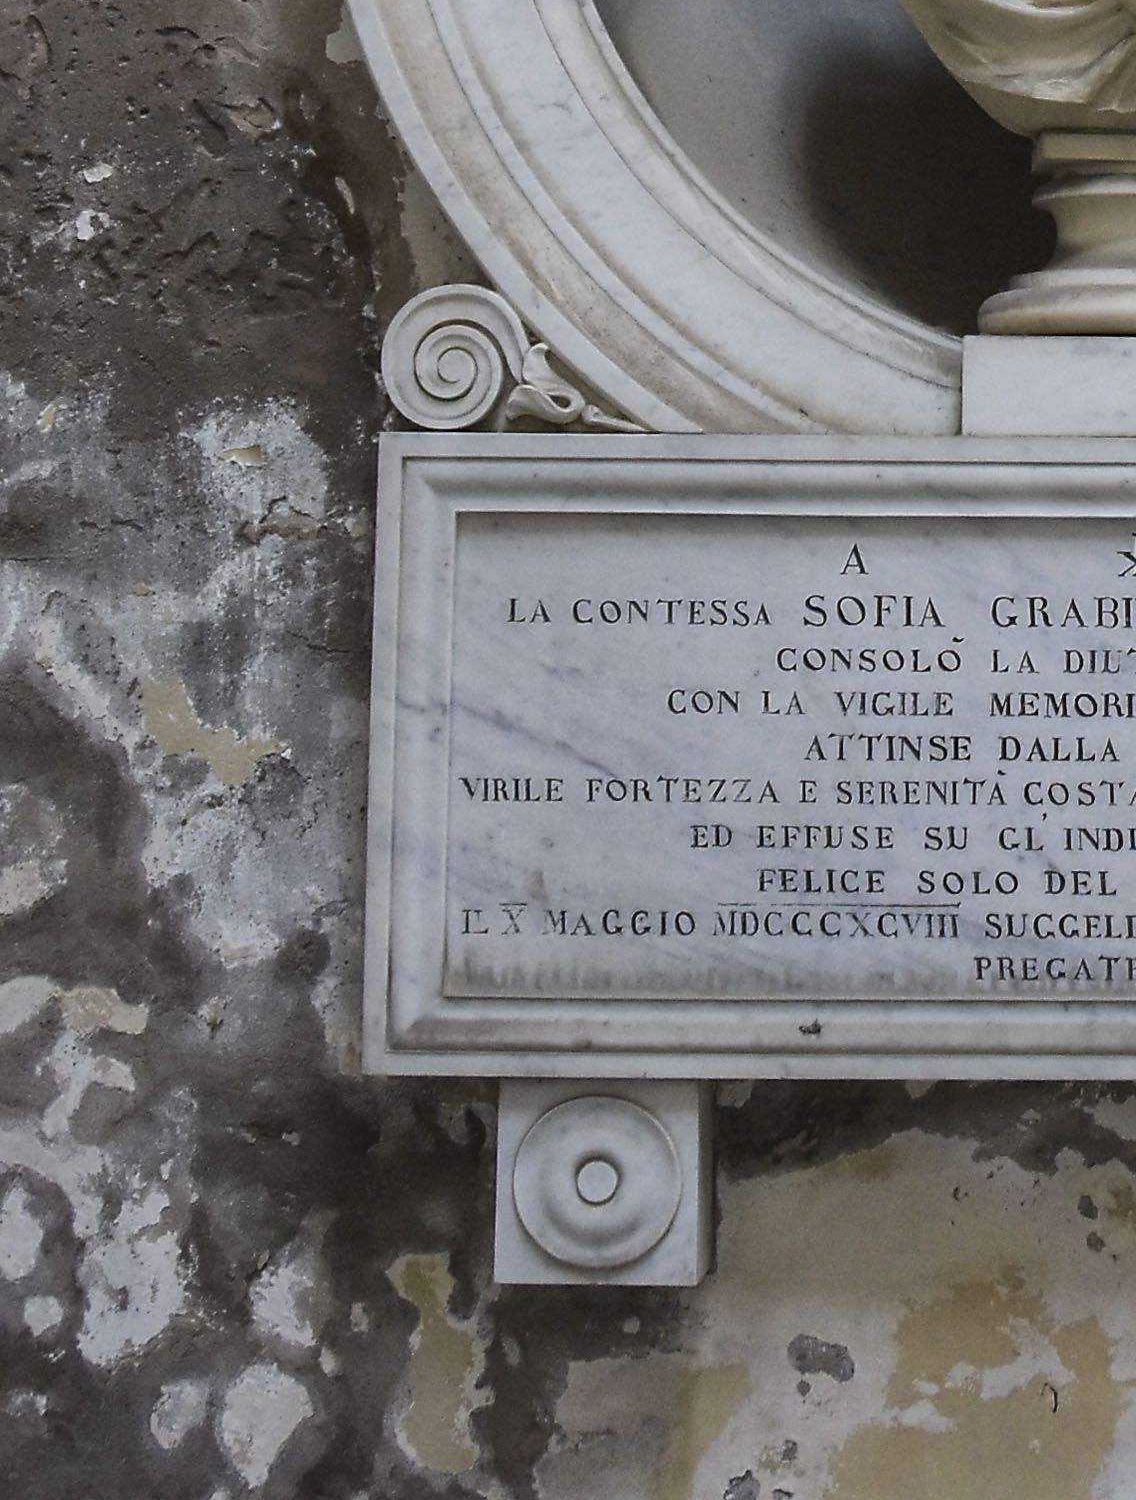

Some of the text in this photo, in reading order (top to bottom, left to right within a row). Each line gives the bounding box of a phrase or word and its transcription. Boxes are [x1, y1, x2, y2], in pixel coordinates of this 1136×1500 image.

[506, 597, 552, 625] LA
[572, 598, 773, 627] CONTESSA
[802, 594, 947, 628] SOFIA
[990, 648, 1040, 675] LA
[667, 688, 741, 715] CON
[761, 690, 806, 716] LA
[834, 690, 955, 717] VIGILE
[803, 732, 972, 762] ATTINSE
[998, 736, 1121, 763] DALLA
[458, 776, 564, 803] VIRILE
[585, 774, 781, 804] FORTEZZA
[798, 779, 818, 804] E
[835, 770, 1007, 807] SERENITÀ
[689, 825, 733, 849] ED
[755, 825, 895, 851] EFFUSE
[923, 826, 969, 851] SU
[757, 868, 886, 895] FELICE
[916, 870, 1019, 896] SOLO
[1043, 870, 1118, 896] DEL
[460, 908, 489, 936] IL
[541, 908, 697, 937] MAGGIO
[711, 901, 963, 939] MDCCCXCVIII
